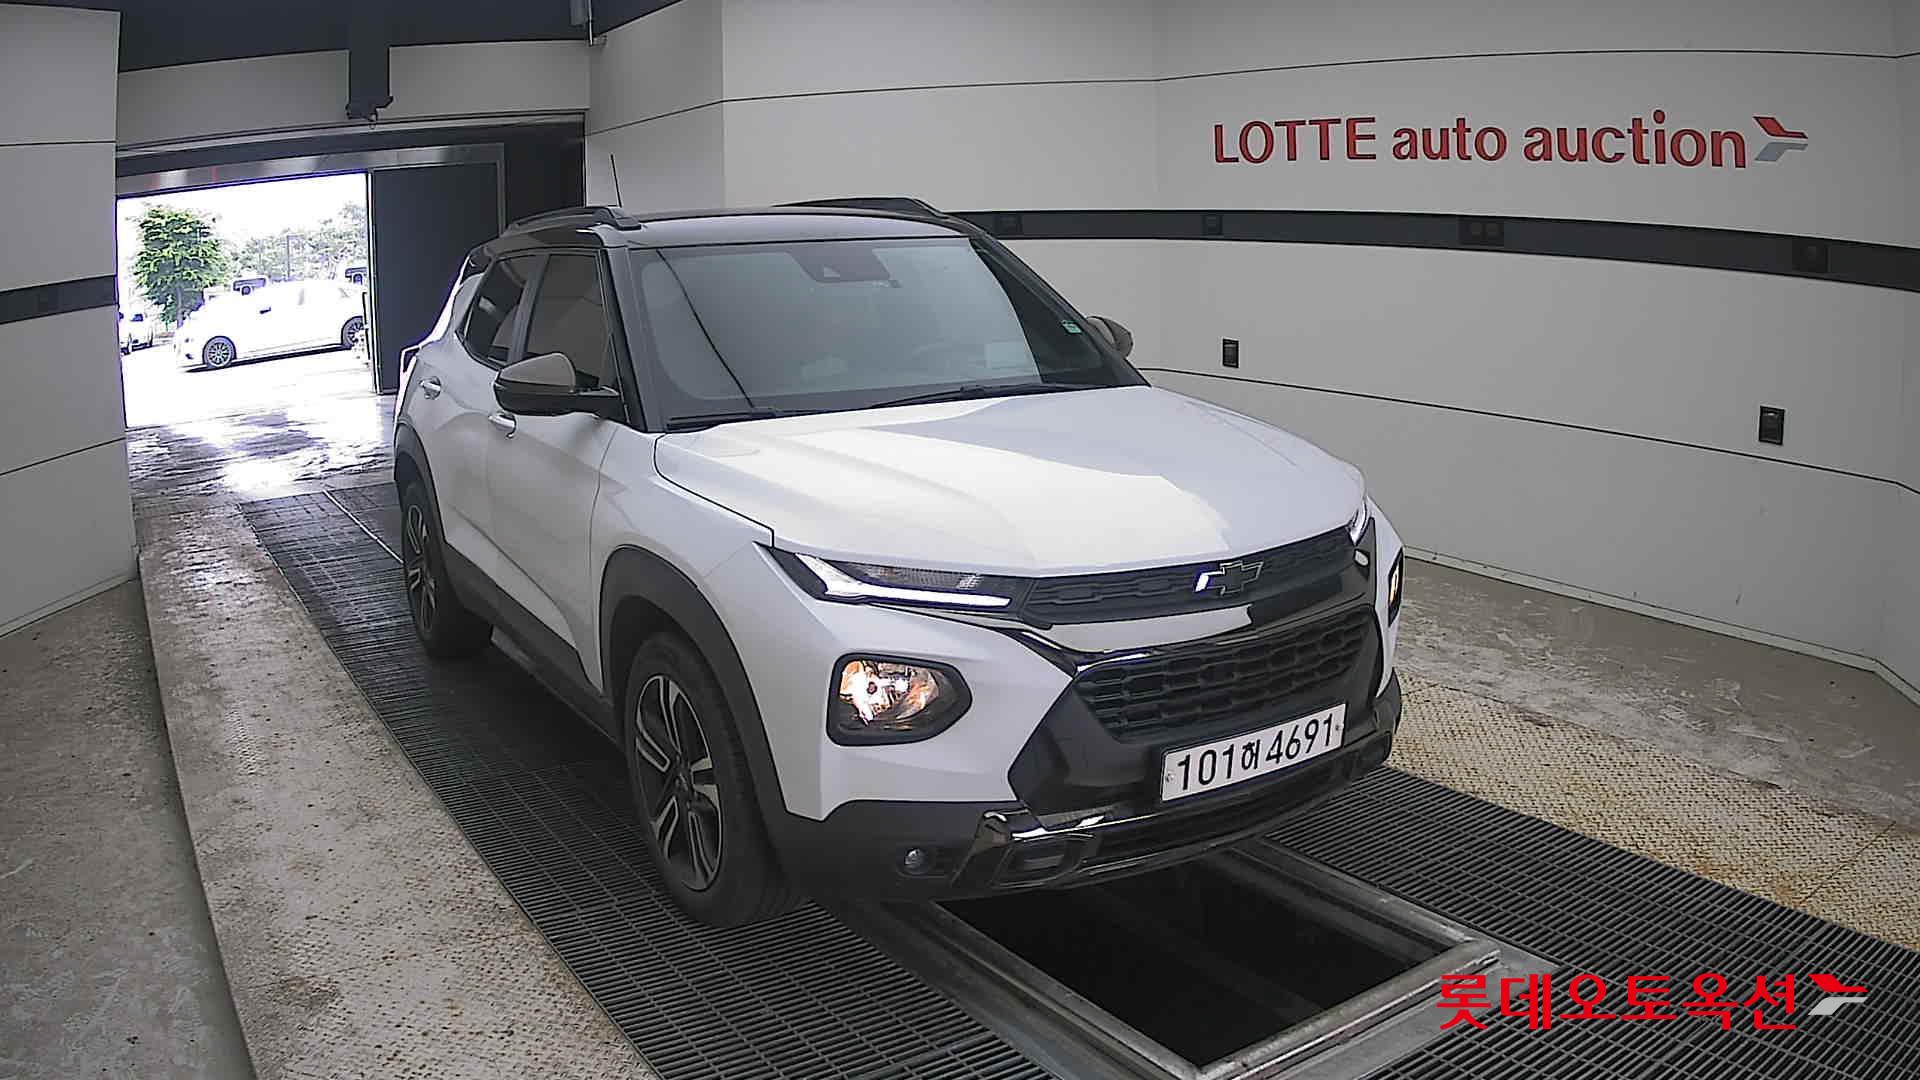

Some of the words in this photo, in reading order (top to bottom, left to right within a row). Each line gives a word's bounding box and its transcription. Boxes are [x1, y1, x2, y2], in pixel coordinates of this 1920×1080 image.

[1213, 116, 1377, 164] LOTTE
[1392, 117, 1507, 162] auto
[1523, 109, 1746, 169] auction
[1177, 713, 1333, 791] 101허4691
